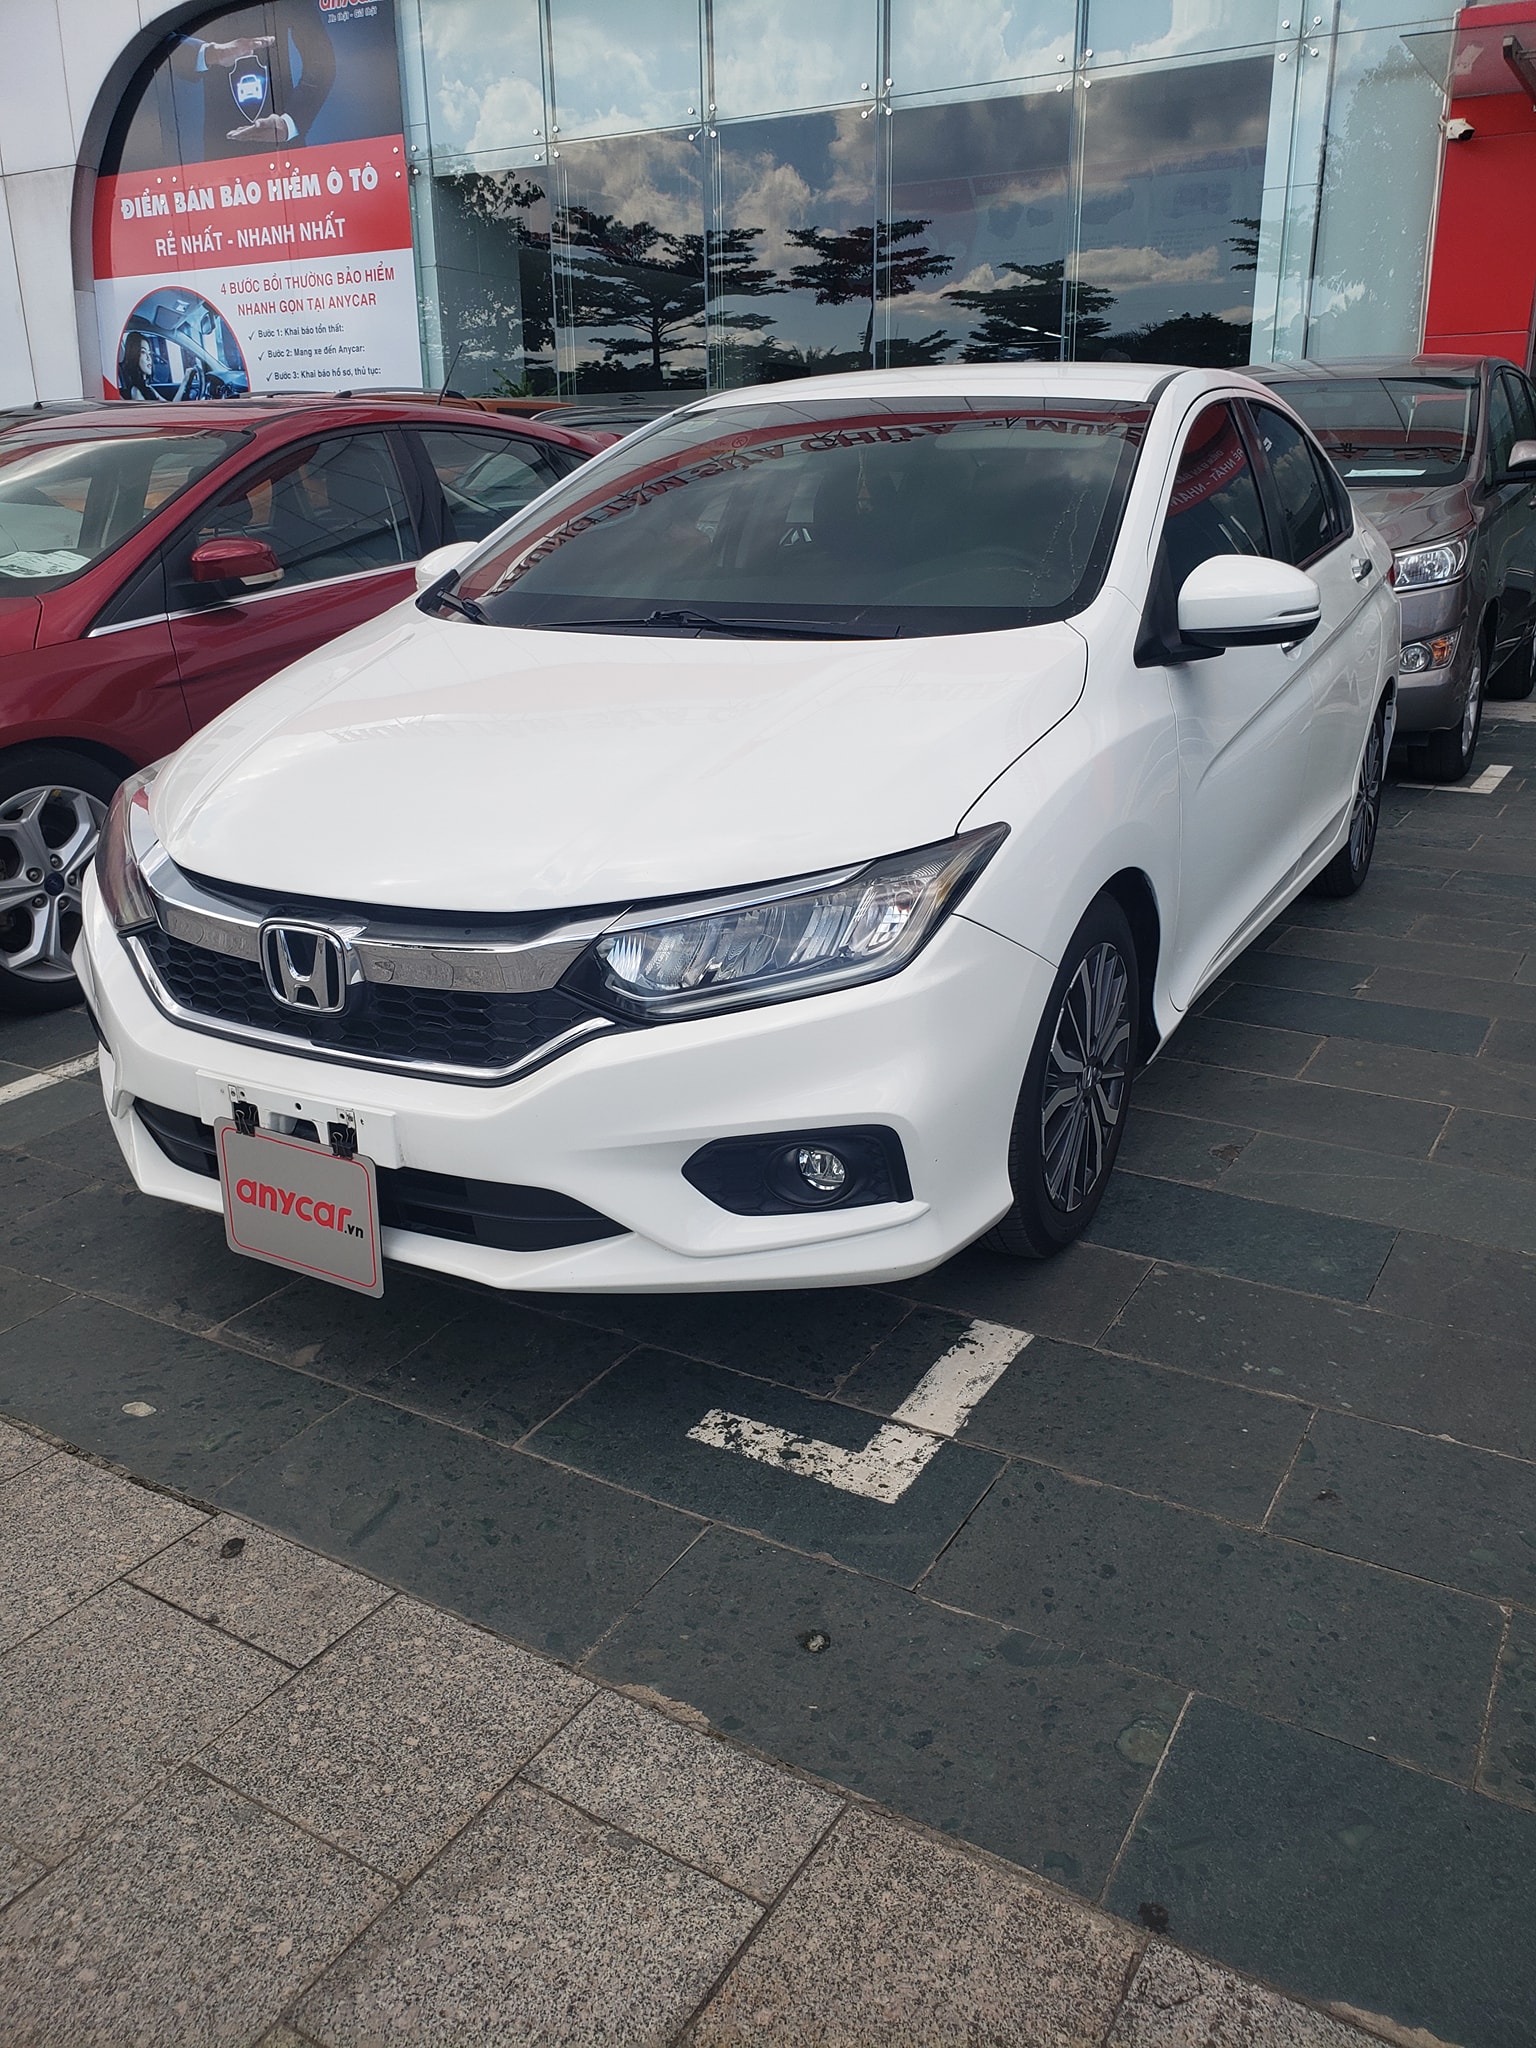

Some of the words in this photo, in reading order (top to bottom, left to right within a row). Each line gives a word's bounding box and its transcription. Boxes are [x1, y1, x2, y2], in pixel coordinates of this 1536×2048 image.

[121, 187, 170, 220] ĐIỂM
[173, 185, 215, 214] BÁN
[219, 177, 262, 208] BẢO
[267, 167, 322, 202] HIỂM
[326, 165, 344, 195] Ô
[348, 161, 378, 192] TÔ
[155, 230, 178, 257] RẺ
[180, 224, 223, 254] NHẤT
[236, 223, 296, 249] NHANH
[299, 210, 346, 242] NHẤT
[220, 282, 227, 296] 4
[229, 275, 260, 295] BƯỚC
[284, 270, 334, 289] THƯỜNG
[337, 266, 362, 285] BẢO
[364, 260, 395, 283] HIỂM
[237, 302, 277, 317] NHANH
[279, 298, 304, 316] GỌN
[306, 296, 326, 313] TẠI
[328, 292, 377, 310] ANYCAR
[284, 326, 300, 336] Khai
[294, 348, 313, 358] Mang
[314, 348, 322, 356] xe
[338, 344, 366, 356] Anycar:
[300, 368, 316, 379] Khai
